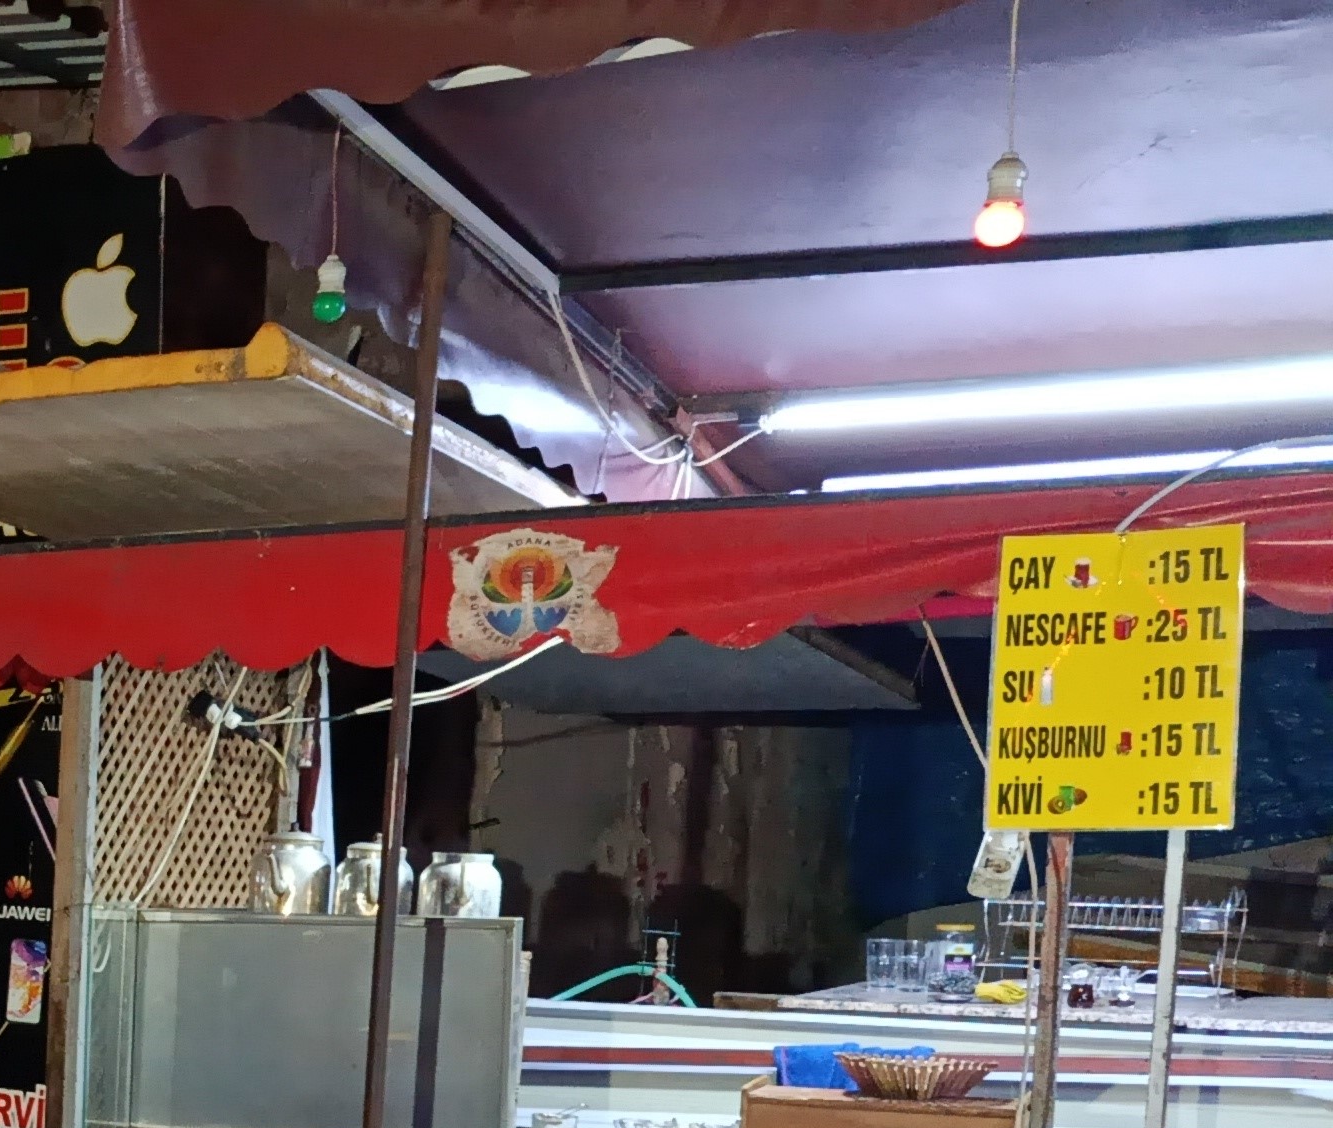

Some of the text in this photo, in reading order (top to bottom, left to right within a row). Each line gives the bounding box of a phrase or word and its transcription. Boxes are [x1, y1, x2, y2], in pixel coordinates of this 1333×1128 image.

[507, 537, 552, 550] ADANA
[1008, 556, 1056, 597] ÇAY
[1199, 547, 1230, 582] TL
[1005, 611, 1107, 647] NESCAFE
[1197, 606, 1227, 641] TL
[1002, 669, 1035, 704] SU
[1194, 664, 1225, 699] TL
[998, 725, 1107, 764] KUŞBURNU
[1192, 722, 1222, 757] TL
[997, 775, 1044, 816] KİVİ
[1189, 781, 1219, 816] TL
